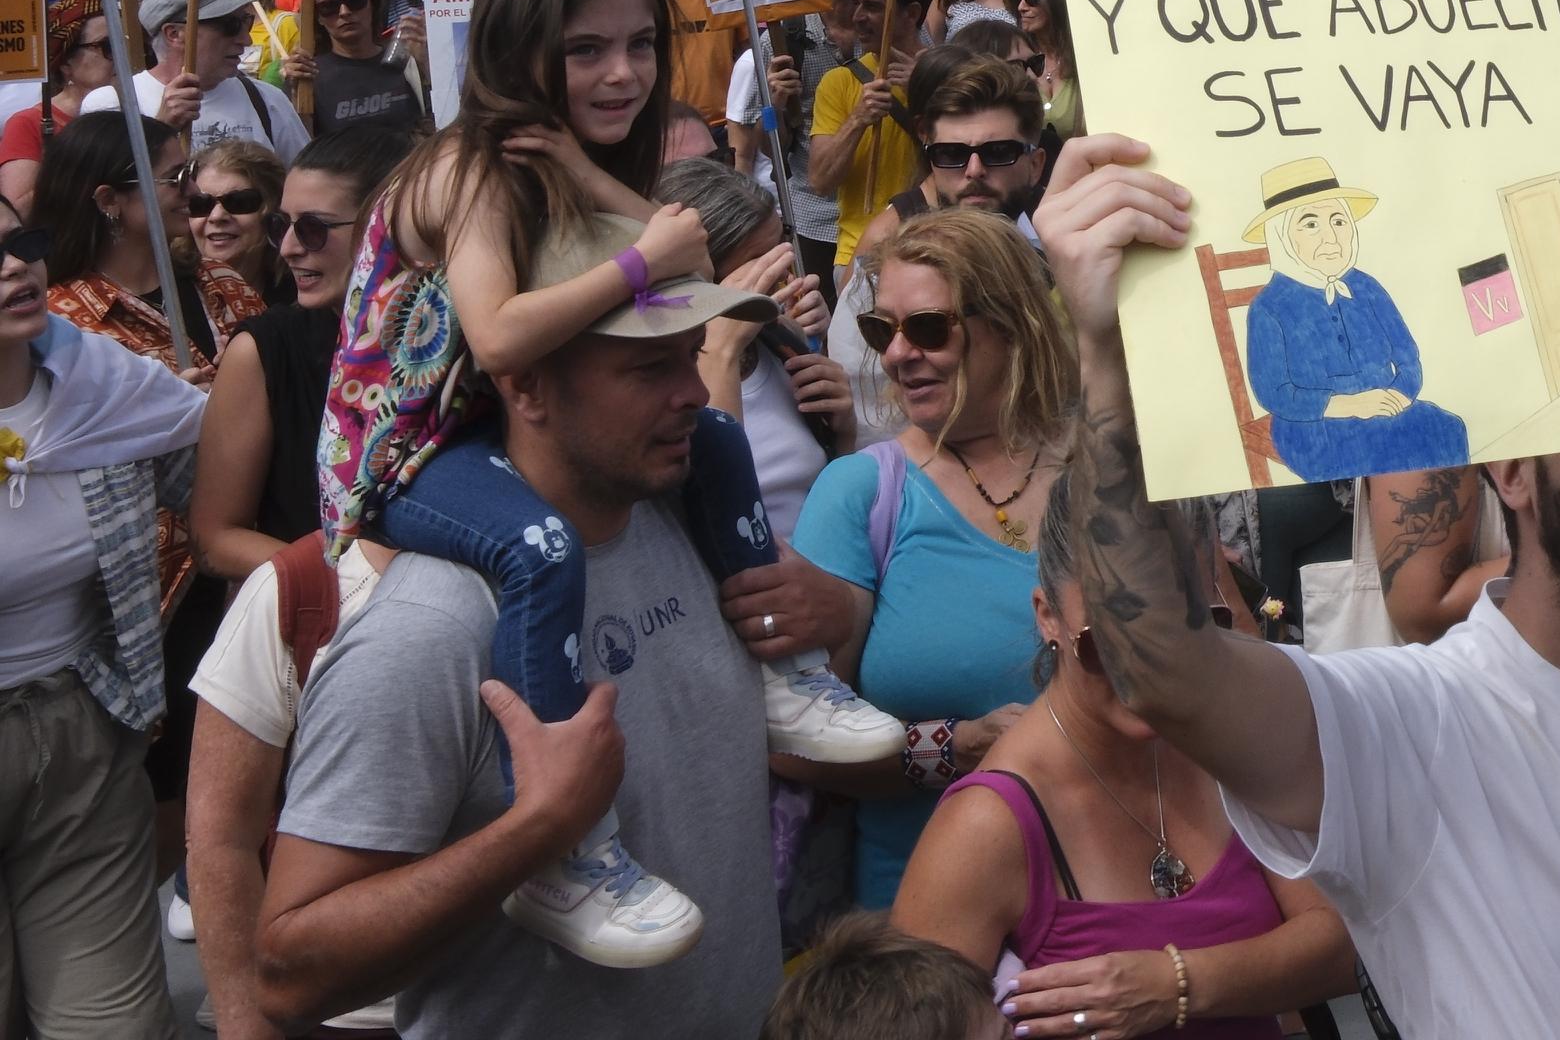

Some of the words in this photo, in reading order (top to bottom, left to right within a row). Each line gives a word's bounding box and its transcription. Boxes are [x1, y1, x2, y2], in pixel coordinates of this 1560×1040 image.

[430, 9, 450, 17] POR
[1203, 67, 1322, 137] SE
[1338, 60, 1533, 132] VAYA
[640, 597, 686, 636] UNR
